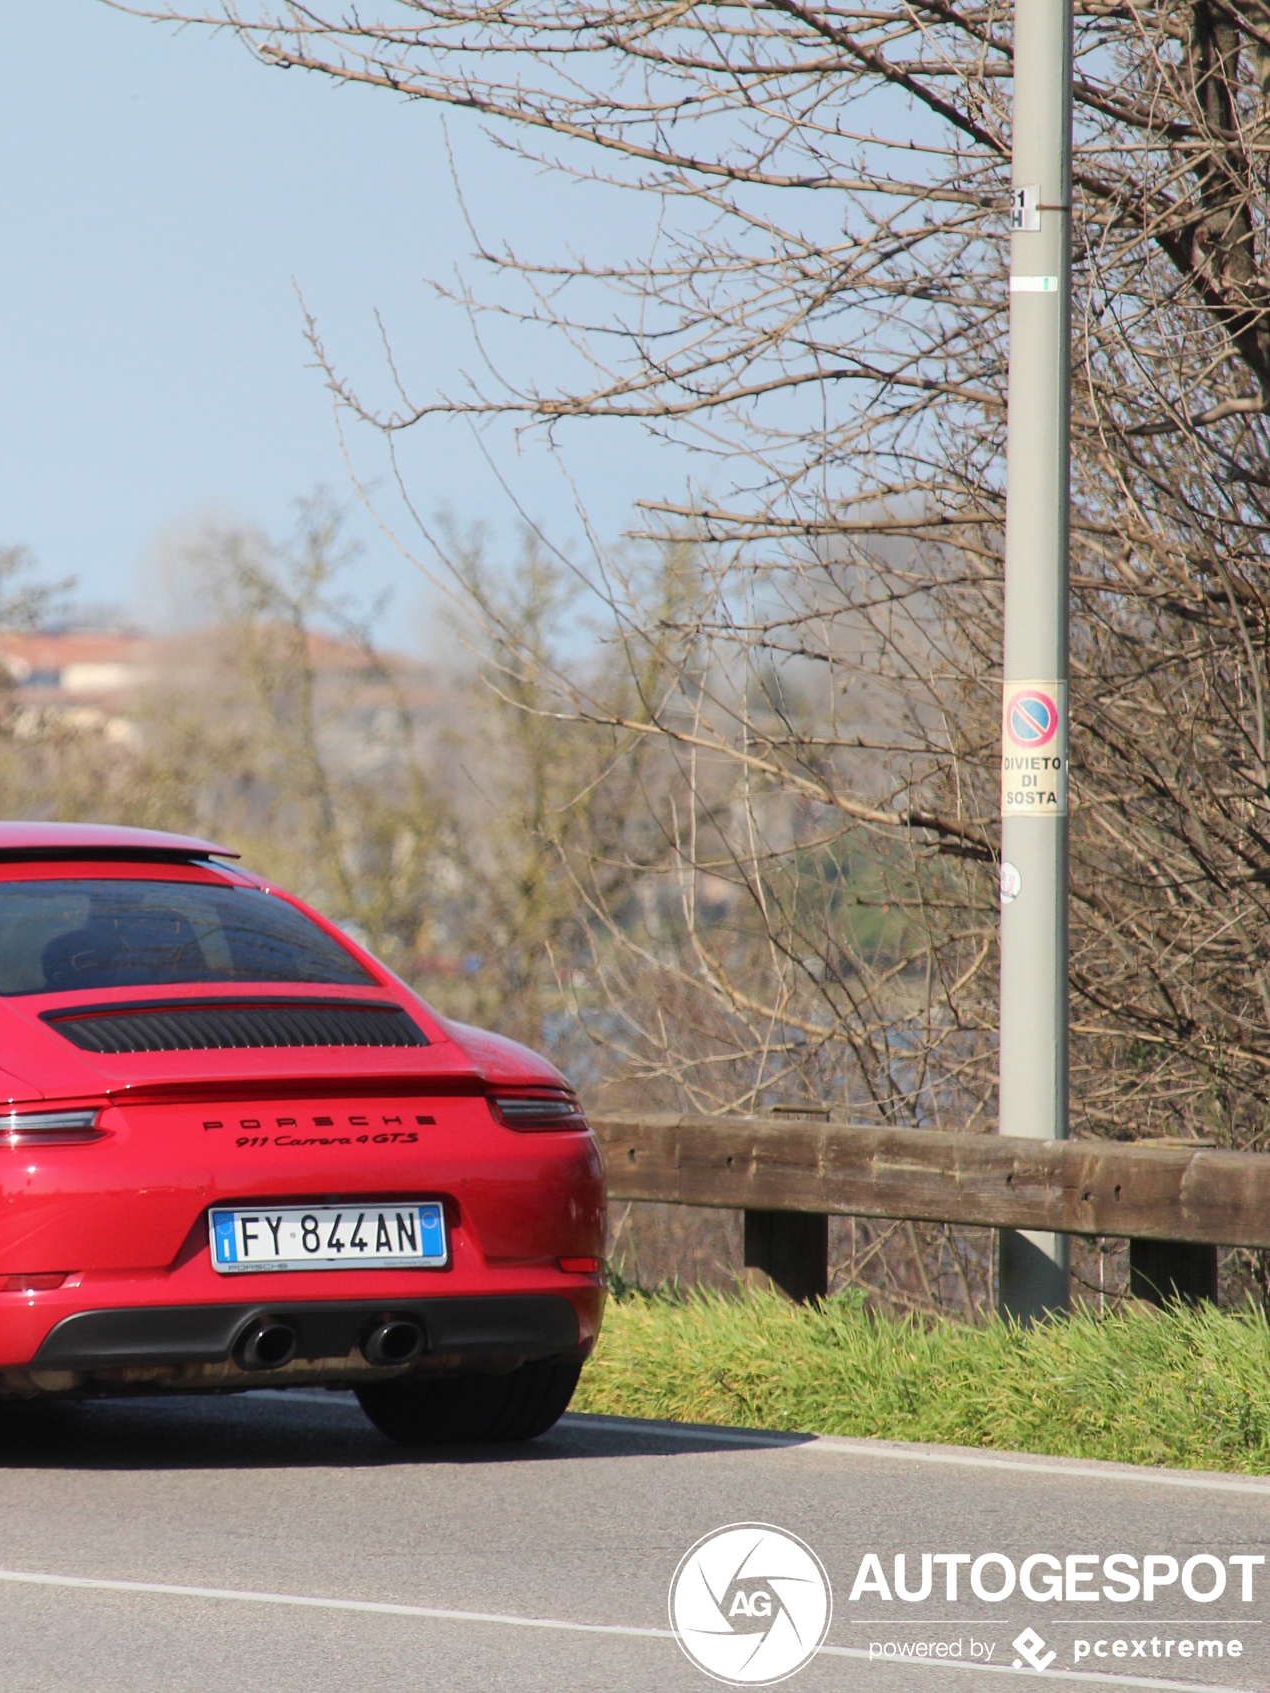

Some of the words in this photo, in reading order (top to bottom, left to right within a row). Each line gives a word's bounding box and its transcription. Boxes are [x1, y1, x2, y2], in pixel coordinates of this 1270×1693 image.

[1004, 757, 1061, 770] DIVIETO
[1022, 774, 1037, 787] DI
[1007, 791, 1058, 804] SOSTA
[203, 1115, 436, 1131] PORSCHE
[236, 1137, 269, 1147] 911
[274, 1135, 352, 1146] Carrera
[241, 1216, 282, 1256] FY
[228, 1263, 288, 1271] PORSCHE
